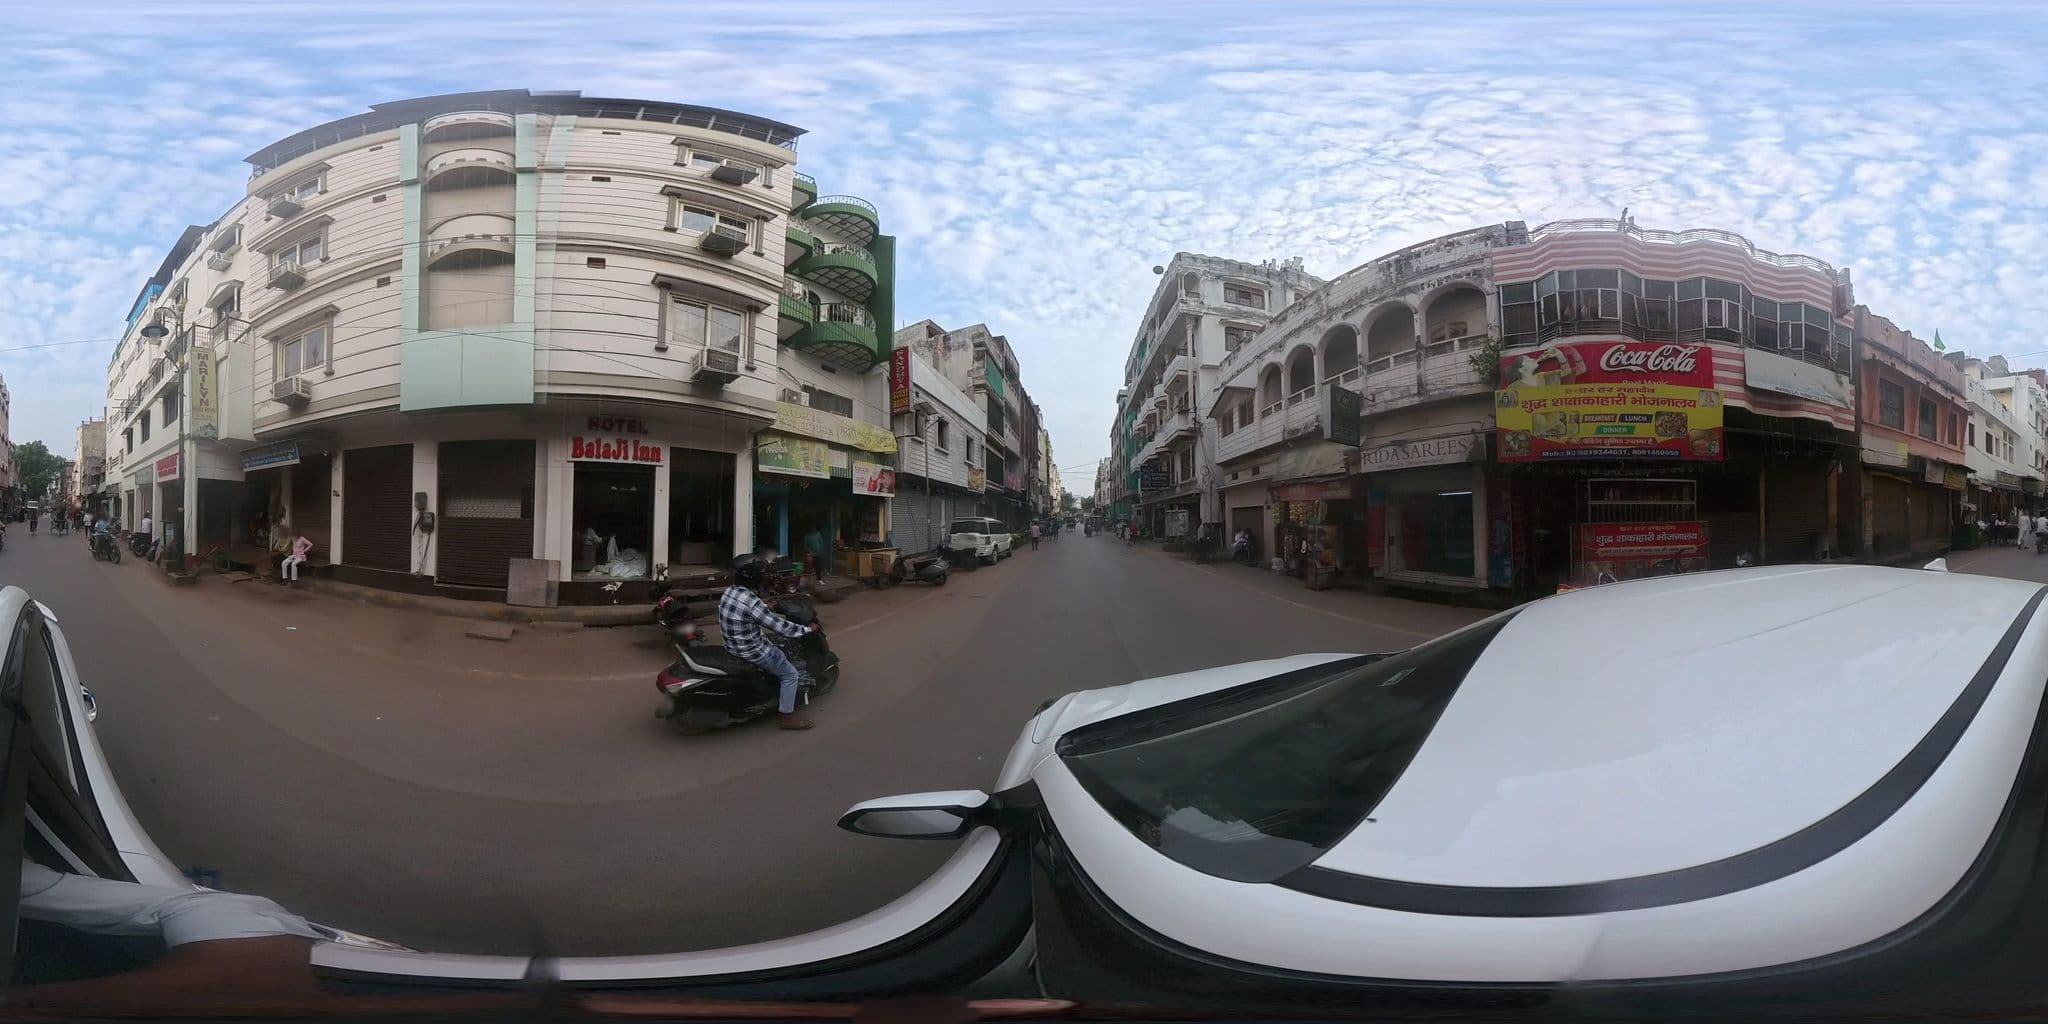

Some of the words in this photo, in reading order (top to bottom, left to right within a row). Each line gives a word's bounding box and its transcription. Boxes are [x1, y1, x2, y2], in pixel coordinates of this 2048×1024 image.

[1600, 345, 1696, 373] Coca-Cola
[198, 352, 210, 406] MARILYN
[1521, 399, 1547, 413] शुद्ध
[1631, 393, 1697, 408] भोजनालय
[588, 417, 648, 434] HOTEL
[572, 436, 629, 460] BalaJi
[632, 439, 662, 463] Inn
[1402, 439, 1467, 459] SAREES
